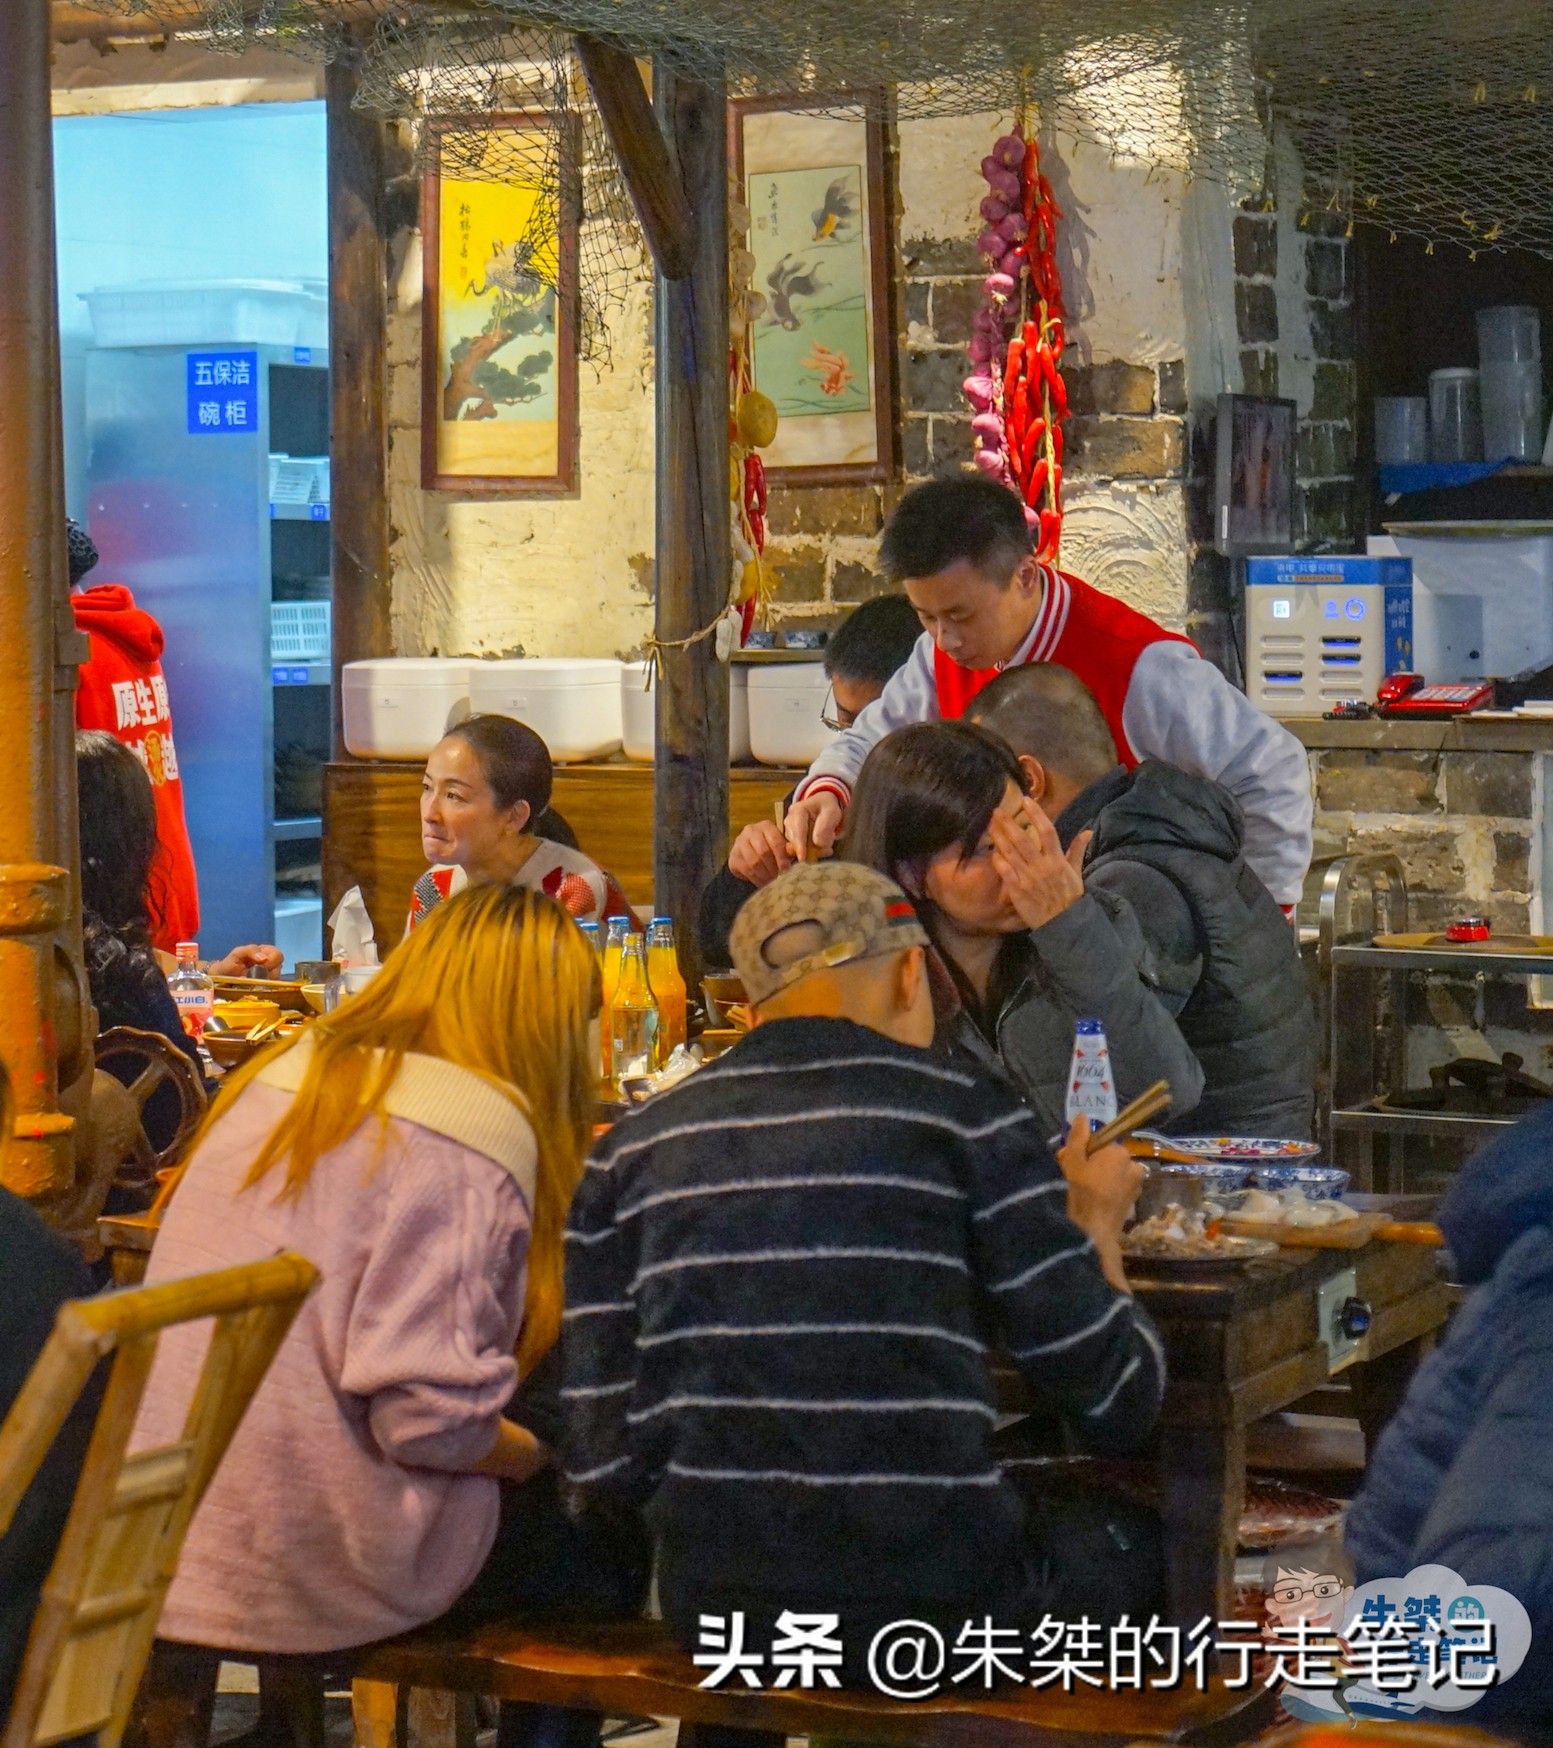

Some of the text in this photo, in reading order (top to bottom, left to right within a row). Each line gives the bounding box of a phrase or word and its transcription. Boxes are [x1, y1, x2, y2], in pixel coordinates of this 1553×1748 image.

[194, 360, 250, 386] 五保洁
[199, 401, 247, 426] 碗柜
[1076, 1063, 1106, 1079] 1664
[1069, 1096, 1117, 1108] BLANC
